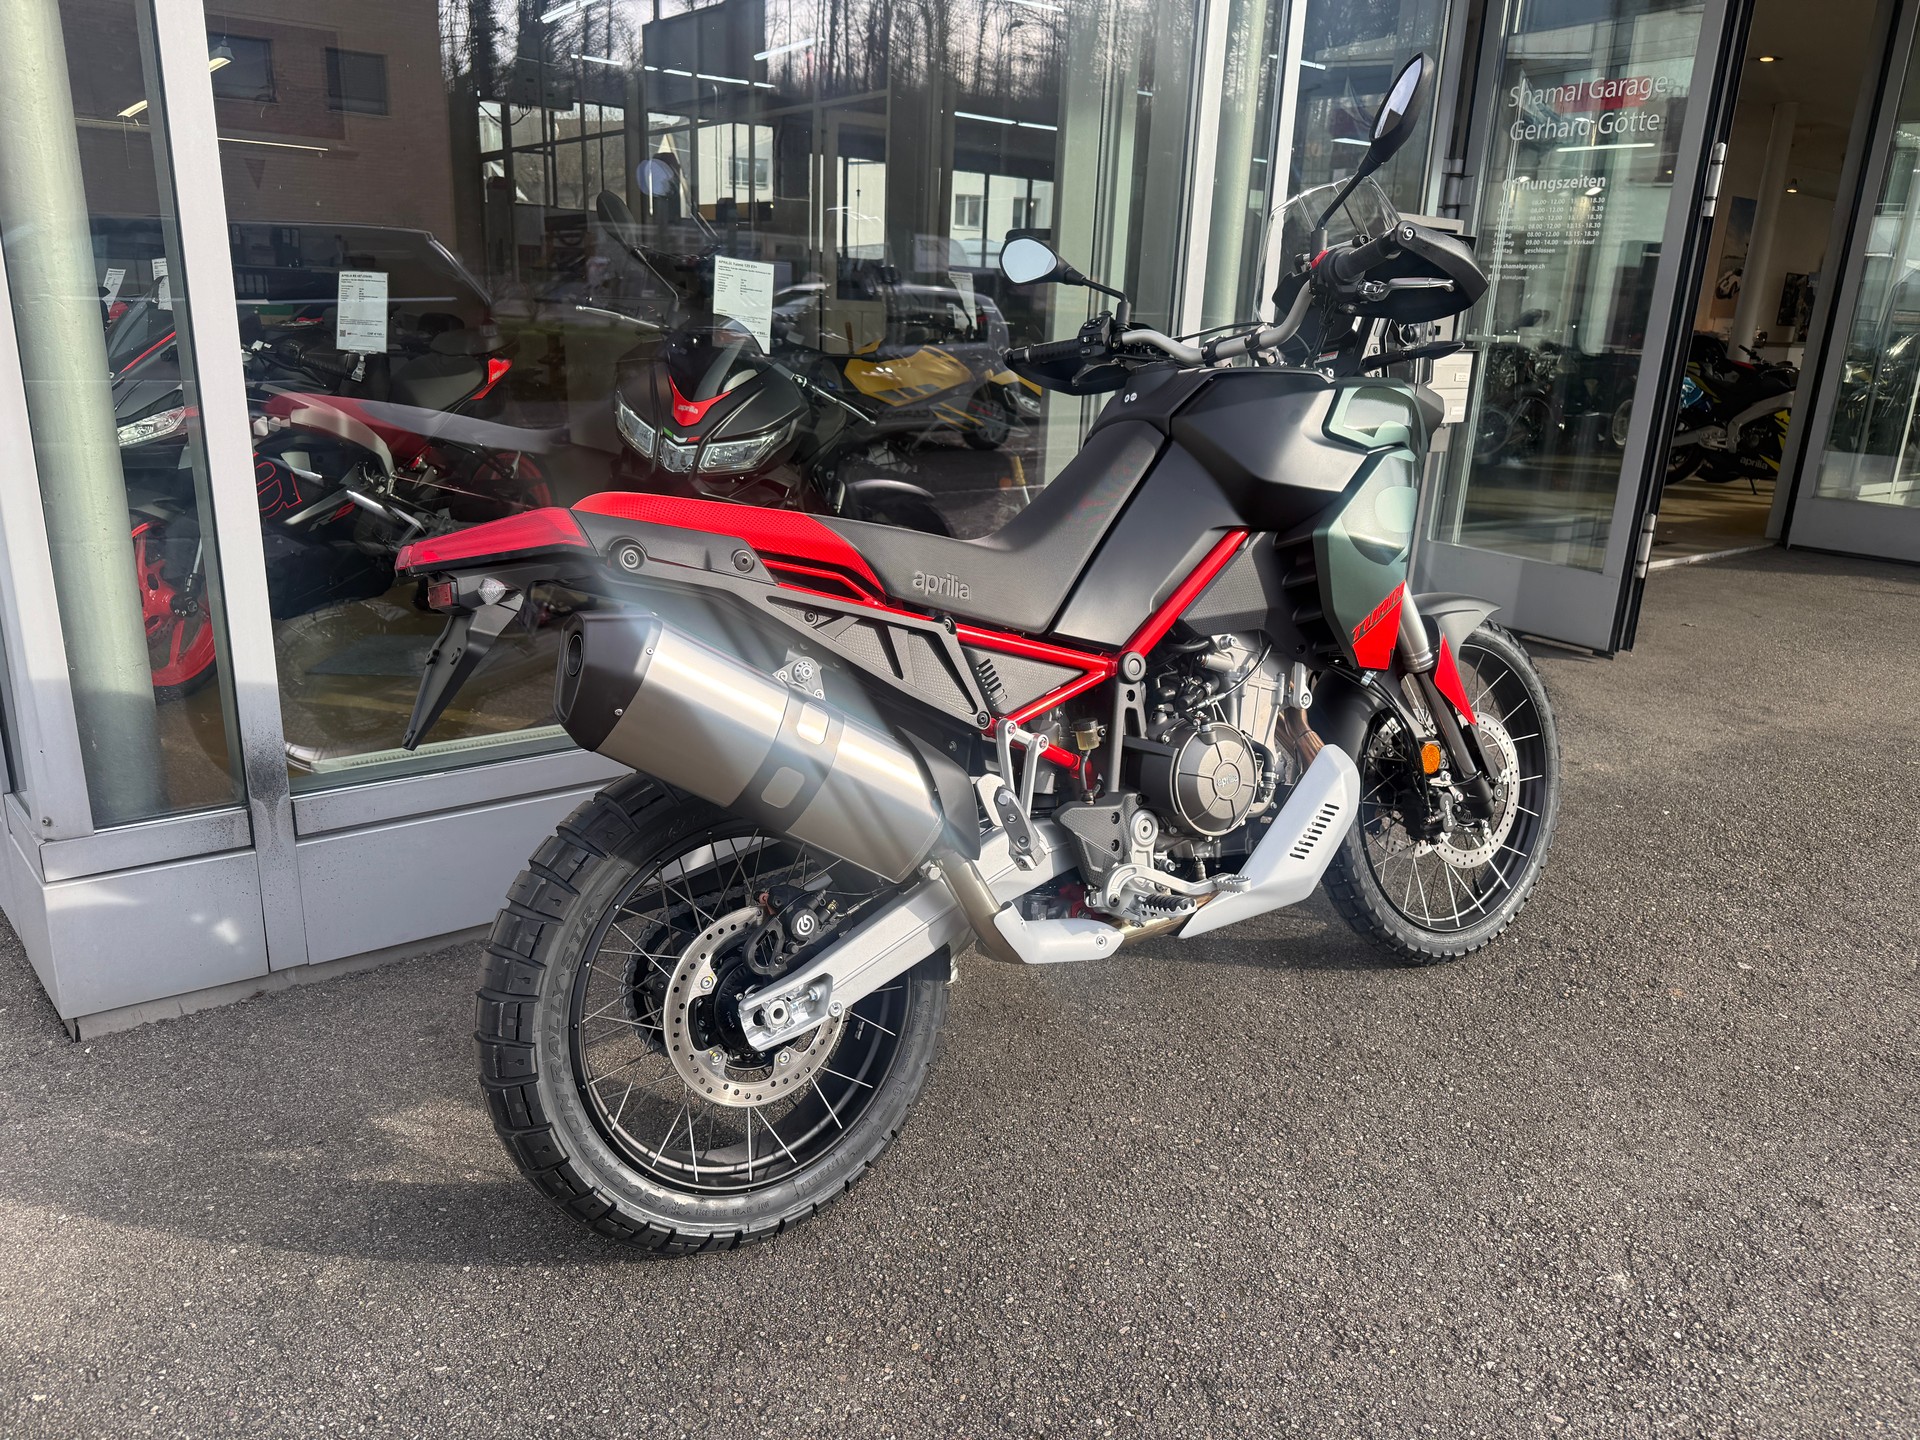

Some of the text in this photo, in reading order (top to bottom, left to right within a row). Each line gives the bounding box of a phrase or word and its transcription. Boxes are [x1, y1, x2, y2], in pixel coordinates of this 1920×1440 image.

[1508, 75, 1669, 107] Shamal Garage
[1510, 112, 1661, 141] Gerhard Götte
[1524, 247, 1555, 255] geschlossen
[1740, 456, 1768, 470] aprilia
[912, 570, 970, 600] aprilia
[547, 971, 571, 1084] RALLY
[560, 904, 598, 971] STR
